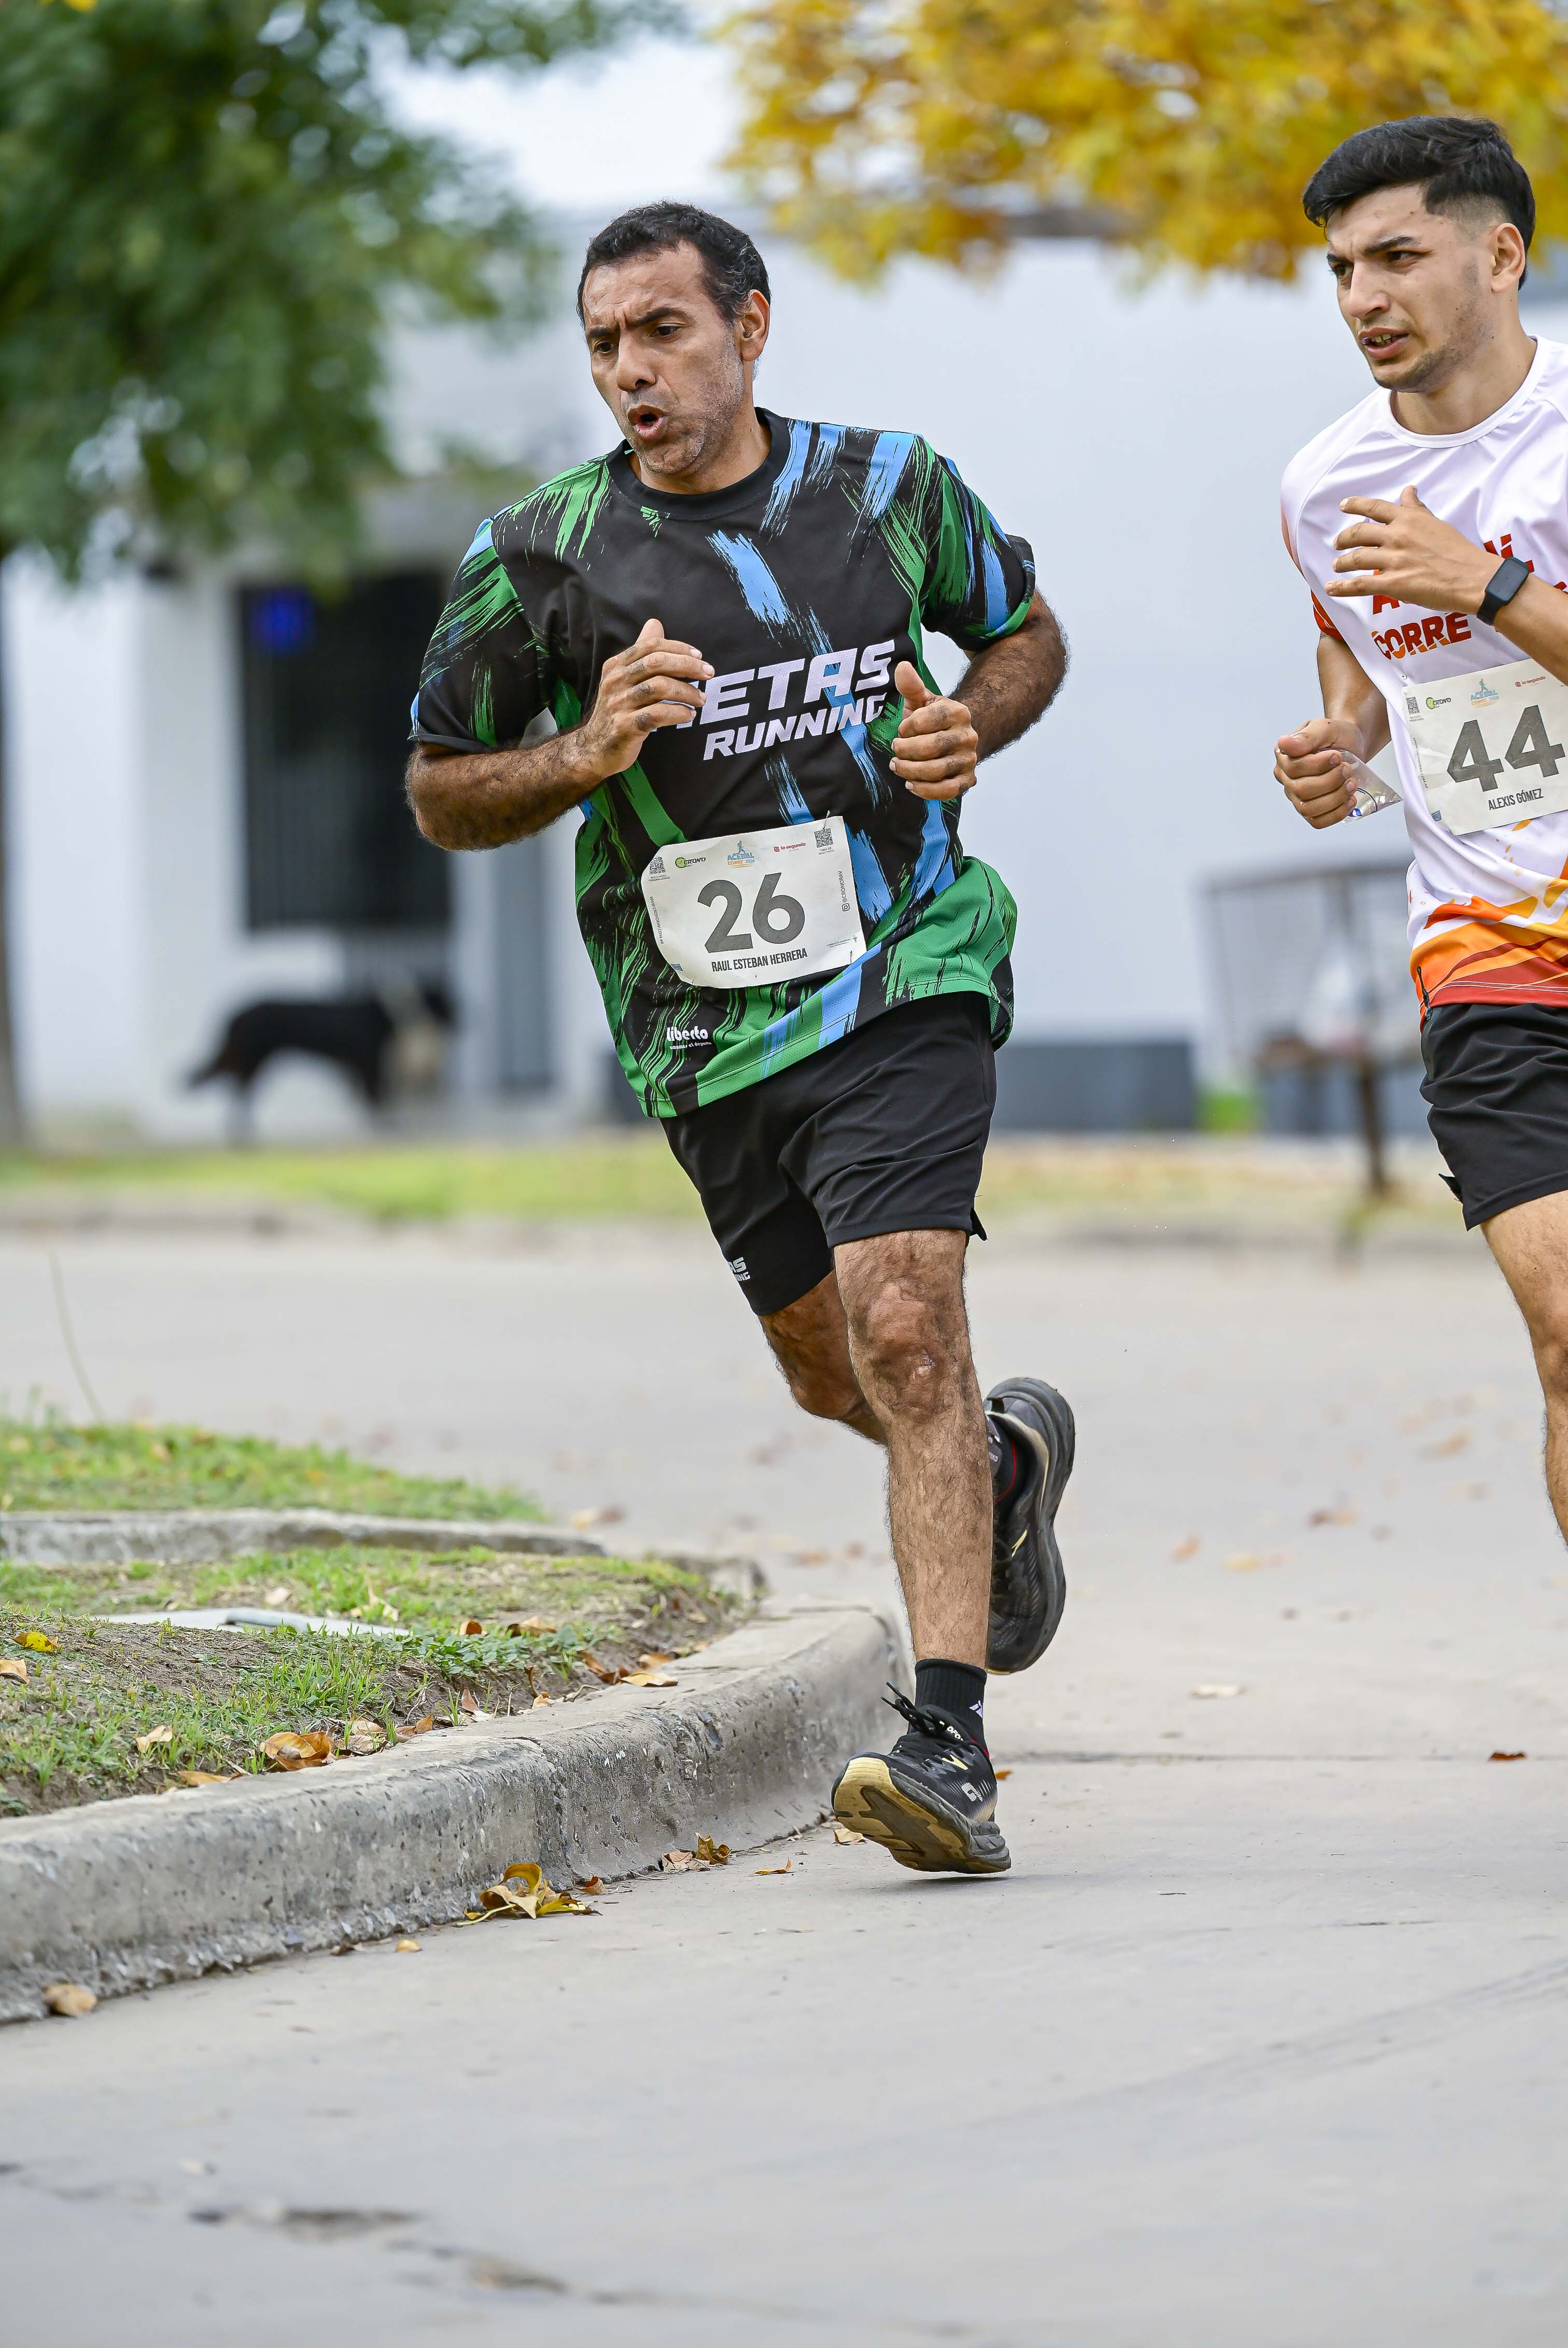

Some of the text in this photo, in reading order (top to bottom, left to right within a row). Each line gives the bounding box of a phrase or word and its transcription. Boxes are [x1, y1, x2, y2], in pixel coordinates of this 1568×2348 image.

[1371, 611, 1472, 660] CORRE
[651, 639, 895, 732] ETAS
[703, 692, 887, 761] RUNNING
[1447, 705, 1566, 792] 44
[1488, 788, 1544, 810] ALEXIS GÓMEZ
[727, 852, 754, 861] ACEBAL
[838, 871, 847, 903] @CRONORAV
[697, 872, 805, 954] 26
[711, 948, 808, 972] RAUL ESTEBAN HERRERA
[666, 1026, 708, 1042] liberto
